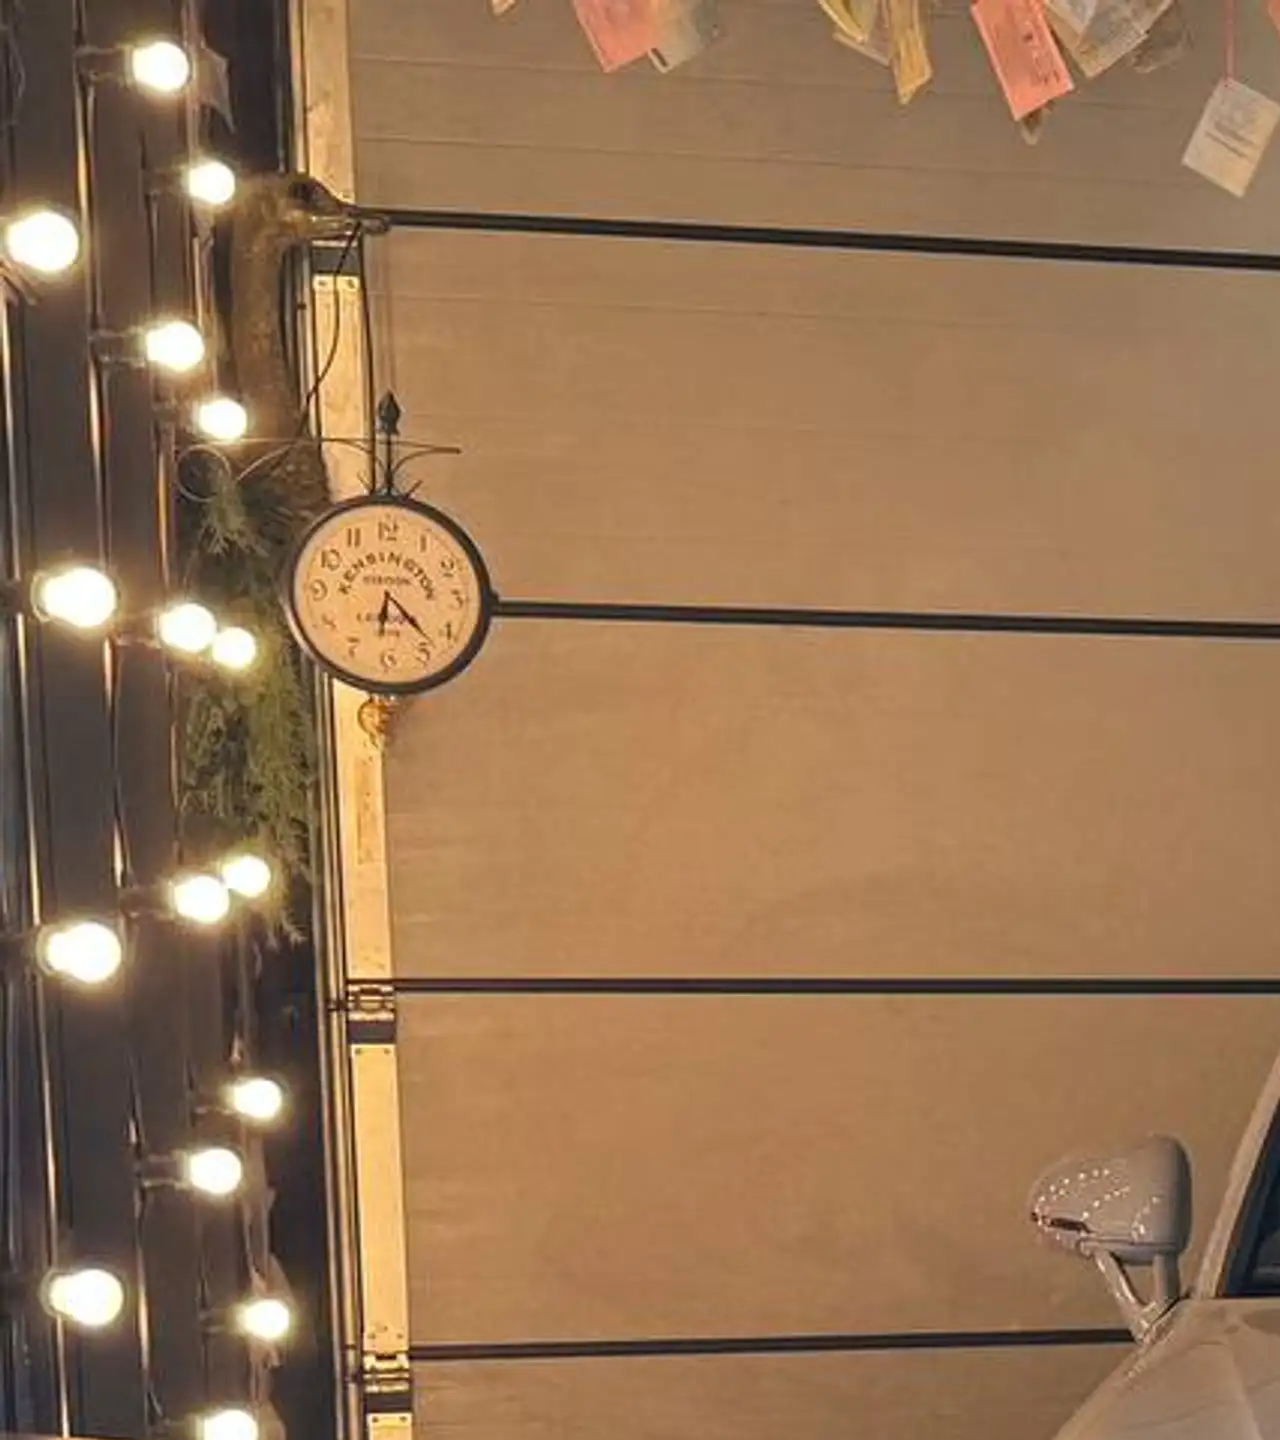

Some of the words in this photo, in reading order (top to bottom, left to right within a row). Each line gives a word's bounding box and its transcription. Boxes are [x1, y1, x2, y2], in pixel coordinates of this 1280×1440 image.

[346, 528, 361, 547] 11
[378, 520, 398, 541] 12
[321, 549, 342, 571] 10
[310, 579, 328, 600] 9
